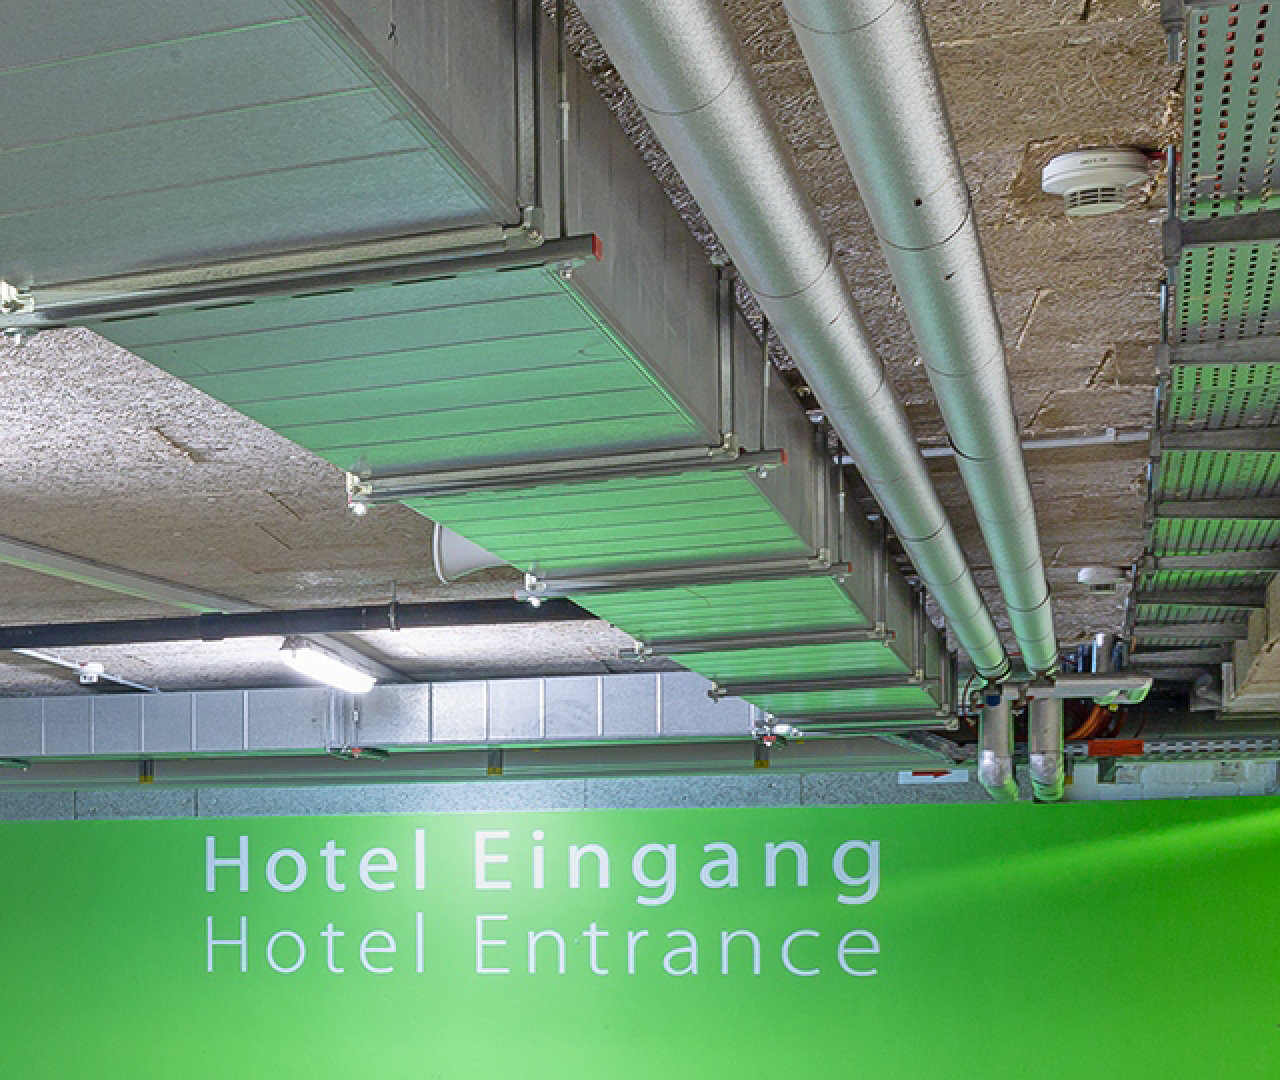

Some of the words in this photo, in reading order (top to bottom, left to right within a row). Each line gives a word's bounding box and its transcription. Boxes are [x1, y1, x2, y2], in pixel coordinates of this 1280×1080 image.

[206, 828, 426, 893] Hotel
[474, 829, 881, 906] Eingang
[207, 911, 425, 973] Hotel
[475, 913, 881, 977] Entrance
